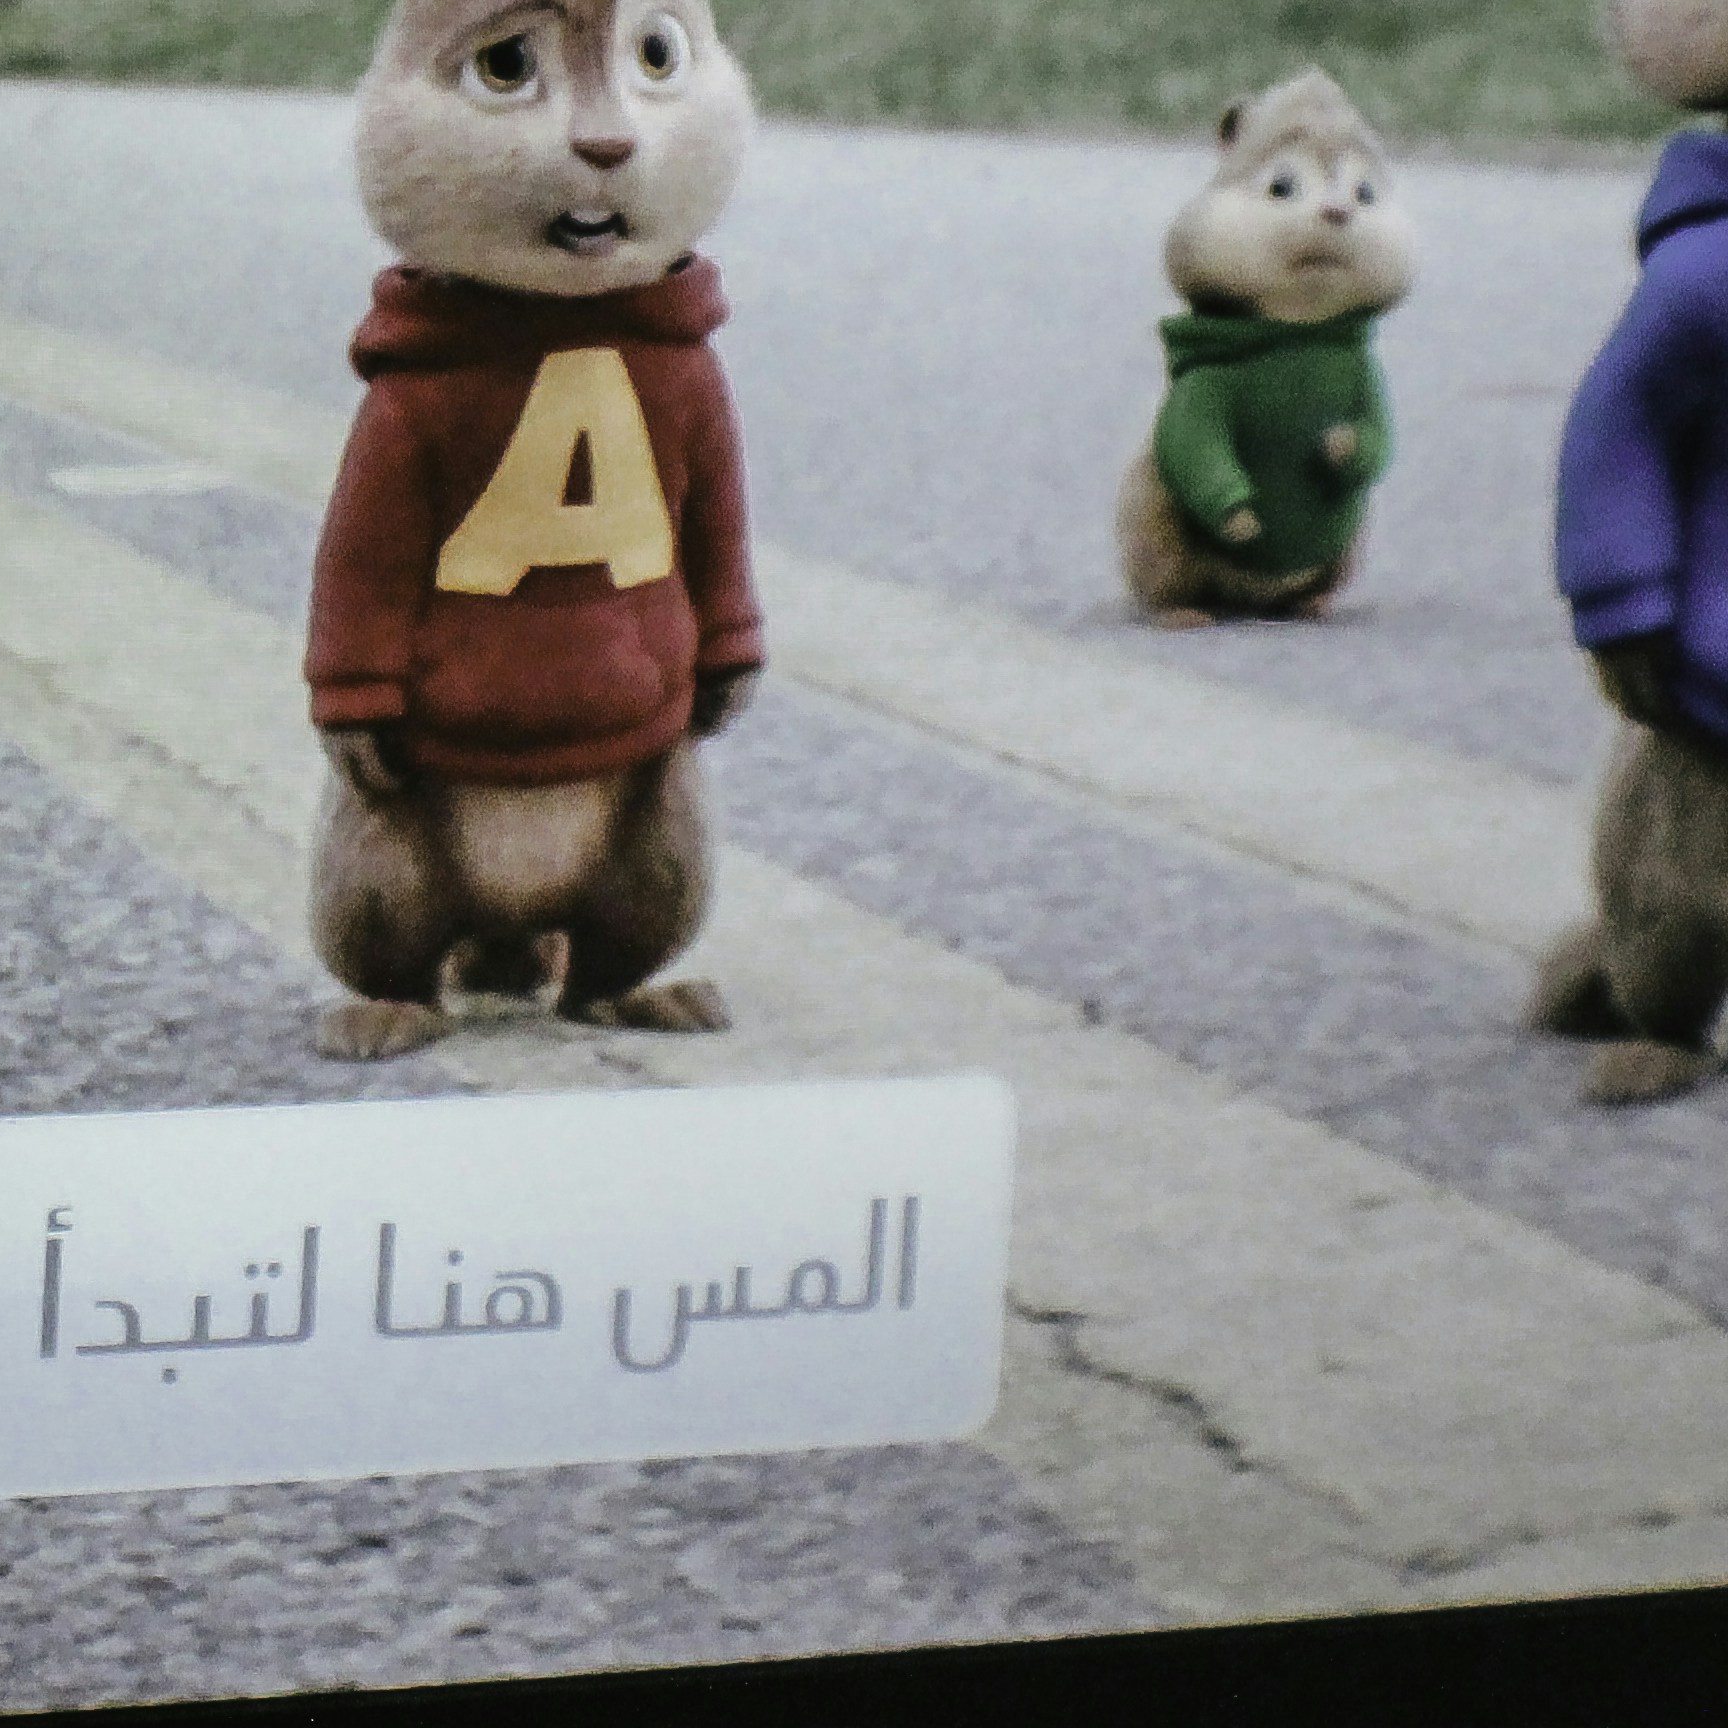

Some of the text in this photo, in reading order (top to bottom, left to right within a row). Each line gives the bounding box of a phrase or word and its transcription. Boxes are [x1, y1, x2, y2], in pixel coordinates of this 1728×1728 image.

[436, 346, 674, 596] A
[38, 1195, 920, 1385] المس هنا لتبدأ
